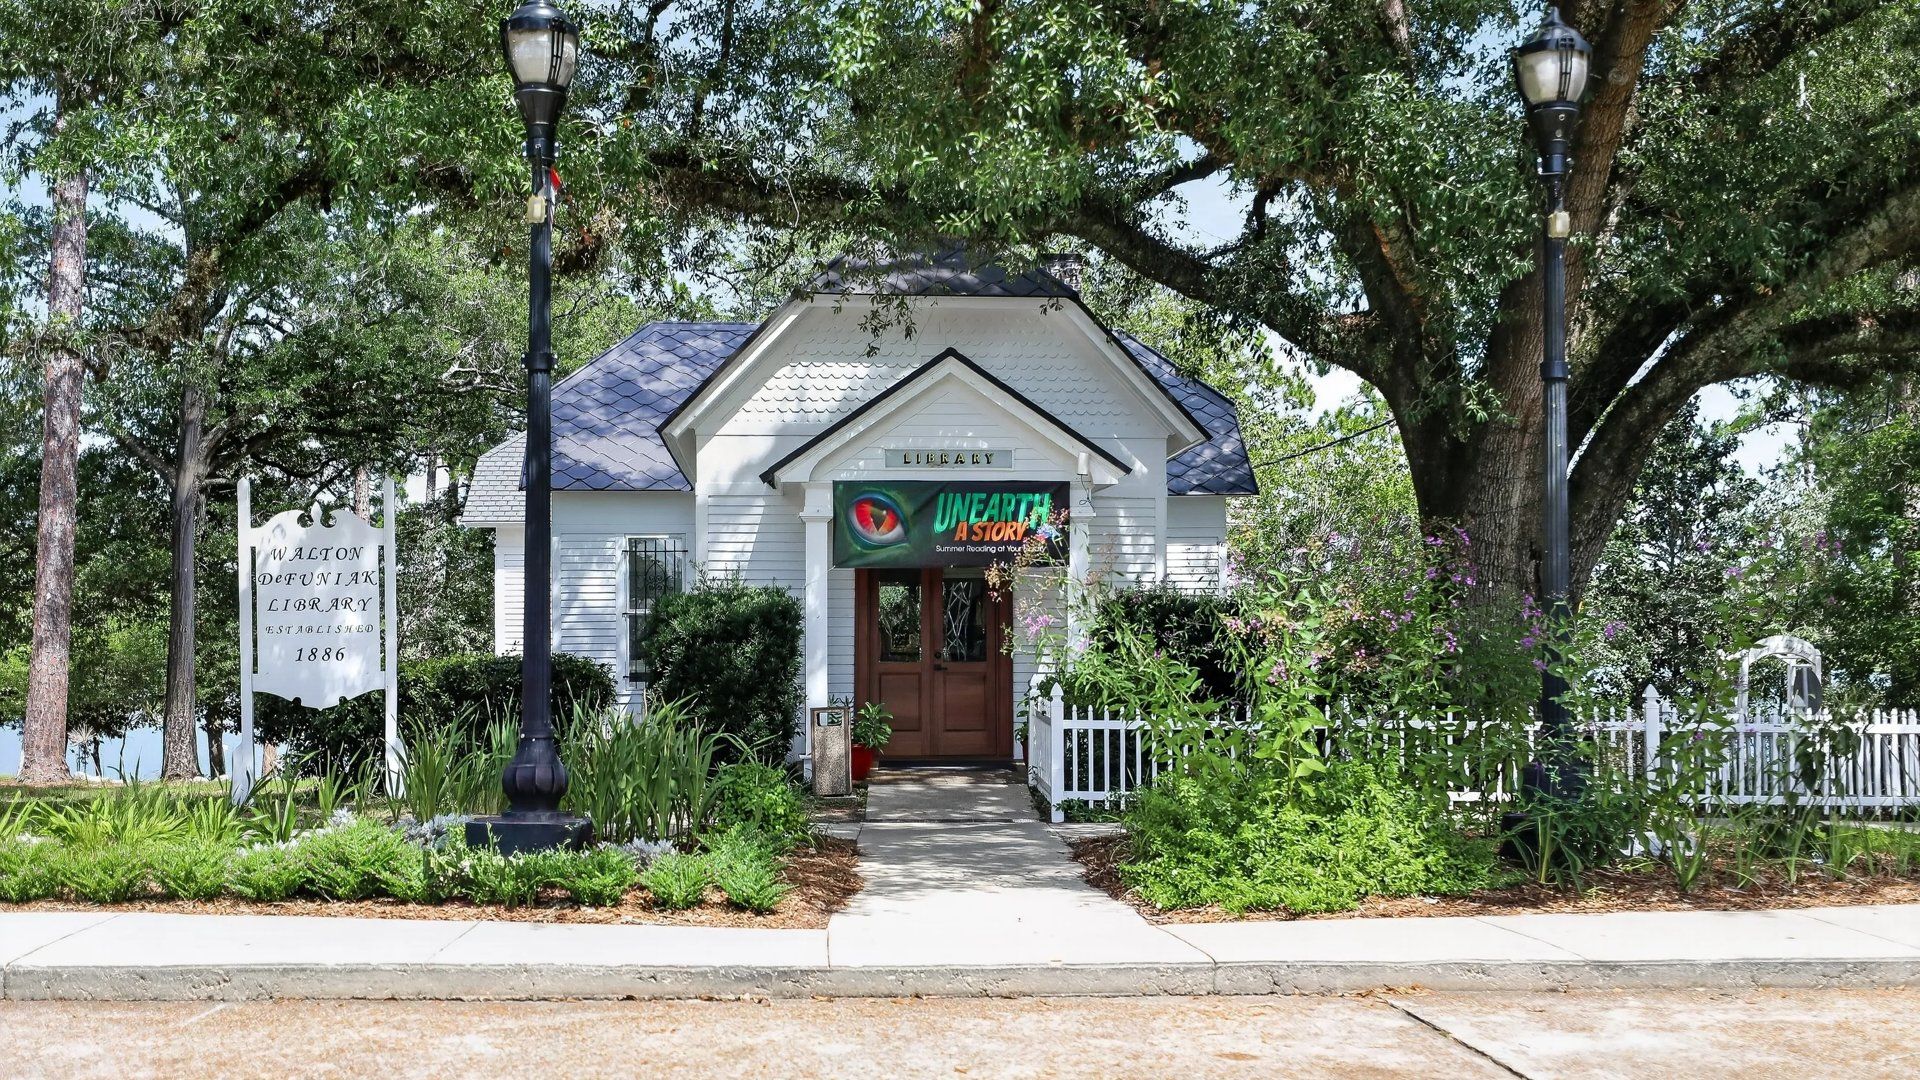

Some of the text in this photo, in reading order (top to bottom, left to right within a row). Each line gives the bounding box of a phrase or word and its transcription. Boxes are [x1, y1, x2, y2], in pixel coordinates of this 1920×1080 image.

[903, 453, 995, 465] LIBRARY
[934, 492, 1051, 533] UNEARTH
[954, 521, 1028, 541] A STORY
[270, 546, 364, 561] WALTON
[936, 544, 966, 552] Summer
[967, 544, 996, 553] Reading
[1006, 544, 1021, 552] Your
[258, 570, 378, 586] DeFUNIAK
[267, 597, 372, 612] LIBRARY
[265, 624, 374, 634] ESTABLISHED
[295, 647, 346, 662] 1886
